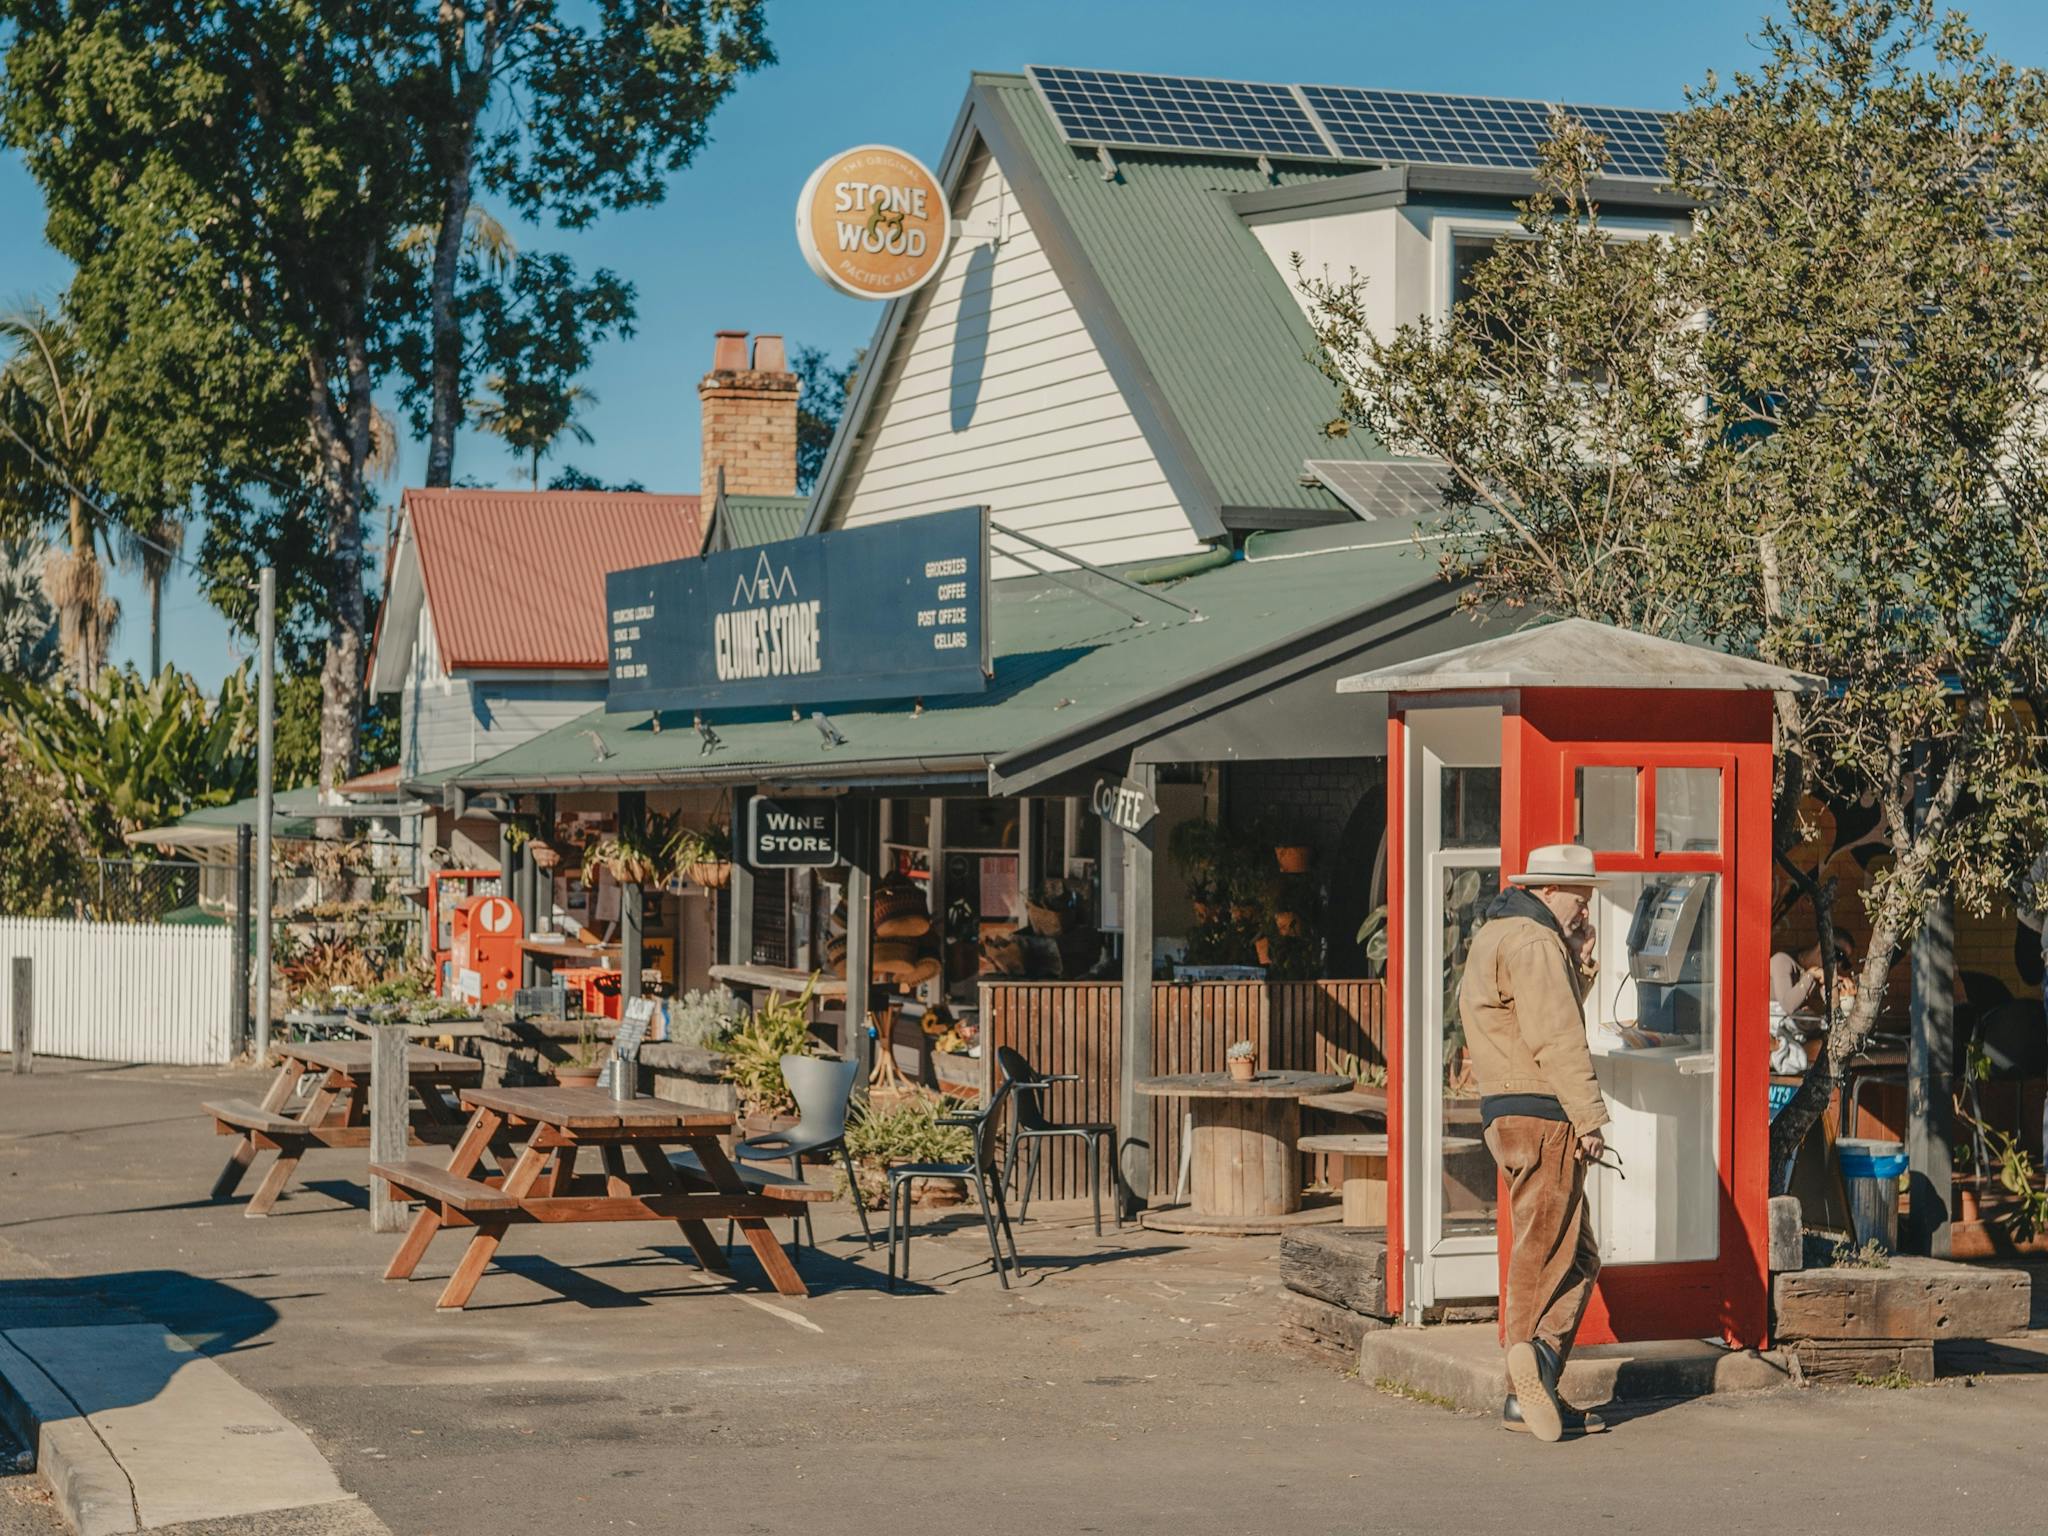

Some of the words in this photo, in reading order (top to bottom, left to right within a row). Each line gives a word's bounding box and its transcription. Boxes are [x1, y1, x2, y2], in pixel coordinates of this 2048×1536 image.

[834, 182, 928, 219] STONE
[836, 221, 927, 257] WOOD
[839, 259, 892, 286] PACIFIC
[895, 267, 917, 284] ALE
[925, 557, 967, 578] GROCERIES
[758, 579, 770, 600] THE
[938, 582, 967, 601] COFFEE
[917, 610, 936, 627] POST
[938, 607, 967, 625] OFFICE
[715, 607, 769, 681] CLUNES
[769, 600, 821, 677] STORE
[934, 632, 968, 650] CELLARS
[1093, 777, 1145, 830] COFFEE
[766, 813, 825, 831] WINE
[760, 834, 832, 852] STORE
